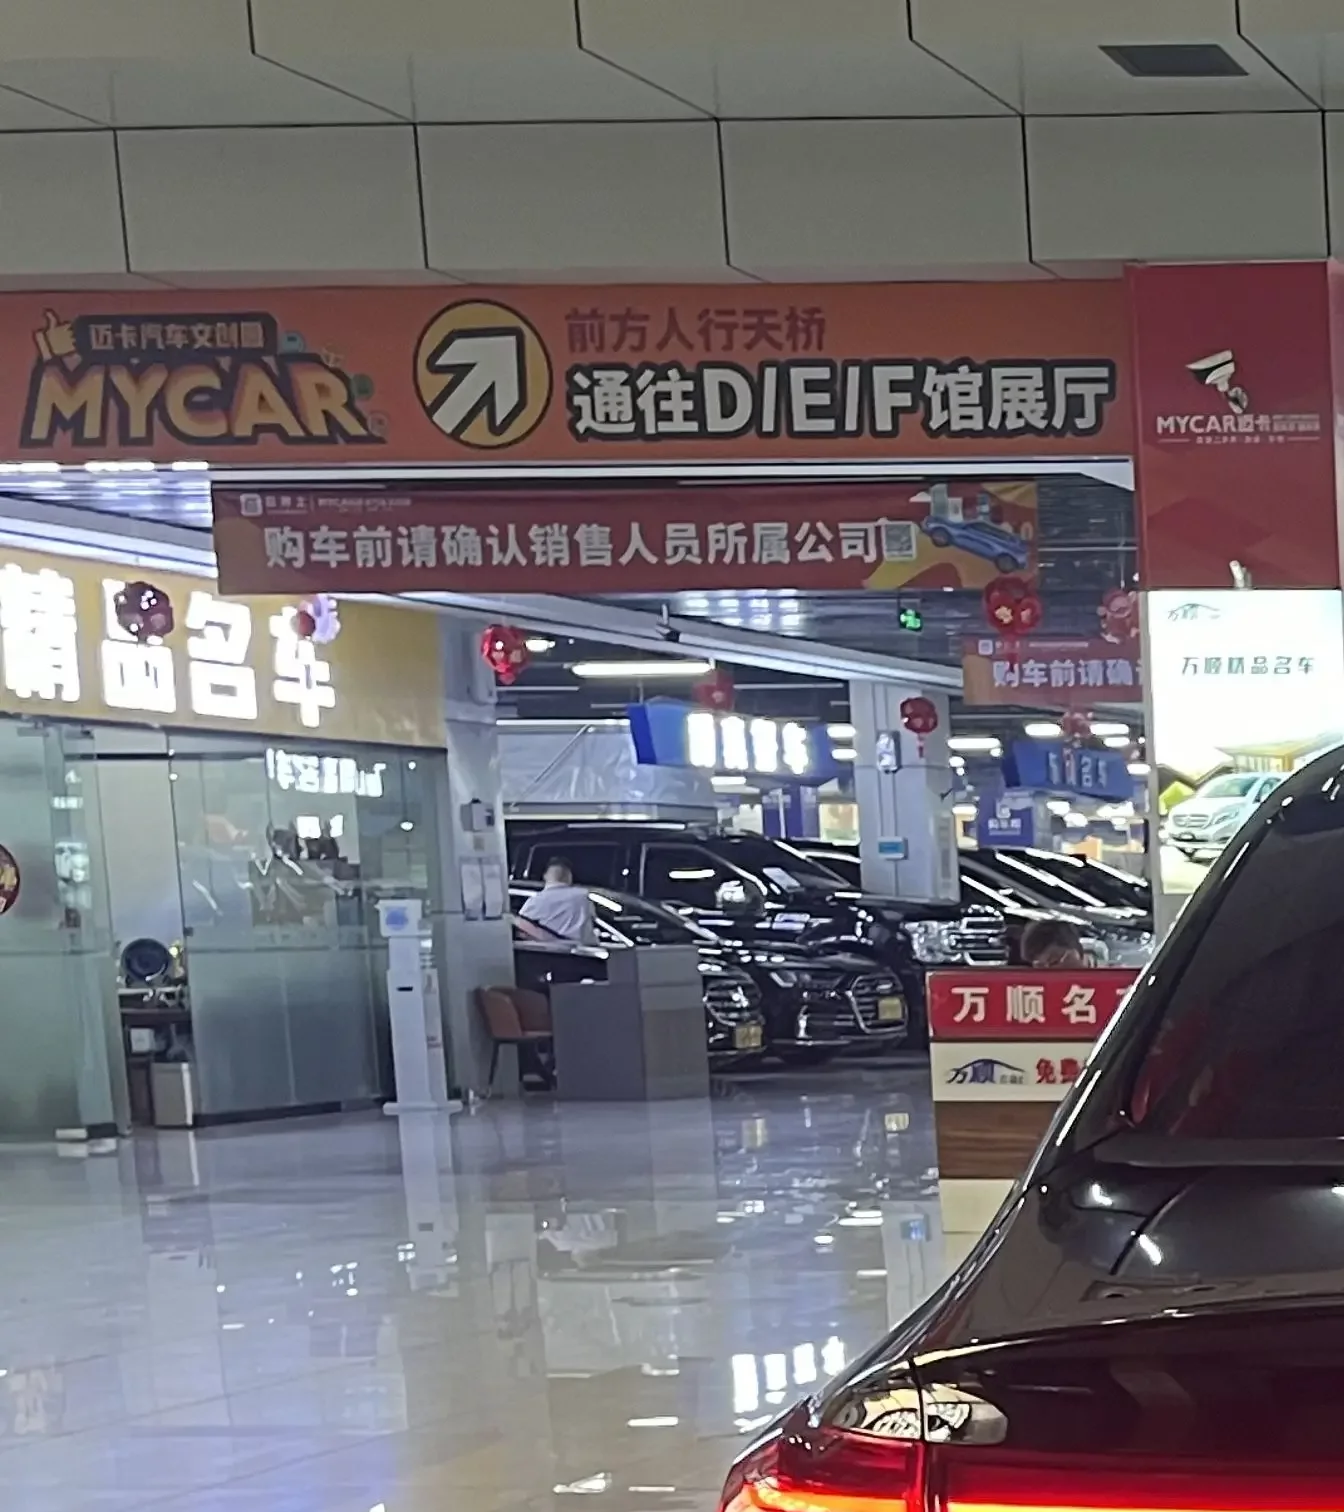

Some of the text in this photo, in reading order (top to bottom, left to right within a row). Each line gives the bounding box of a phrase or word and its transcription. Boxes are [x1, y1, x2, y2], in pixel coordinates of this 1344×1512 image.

[565, 304, 826, 354] 前方人行天桥
[25, 356, 374, 444] MYCAR
[263, 520, 877, 569] 购车前请确认销售人员所属公司
[993, 659, 1143, 687] 购车前请确
[951, 984, 1133, 1024] 万顺名
